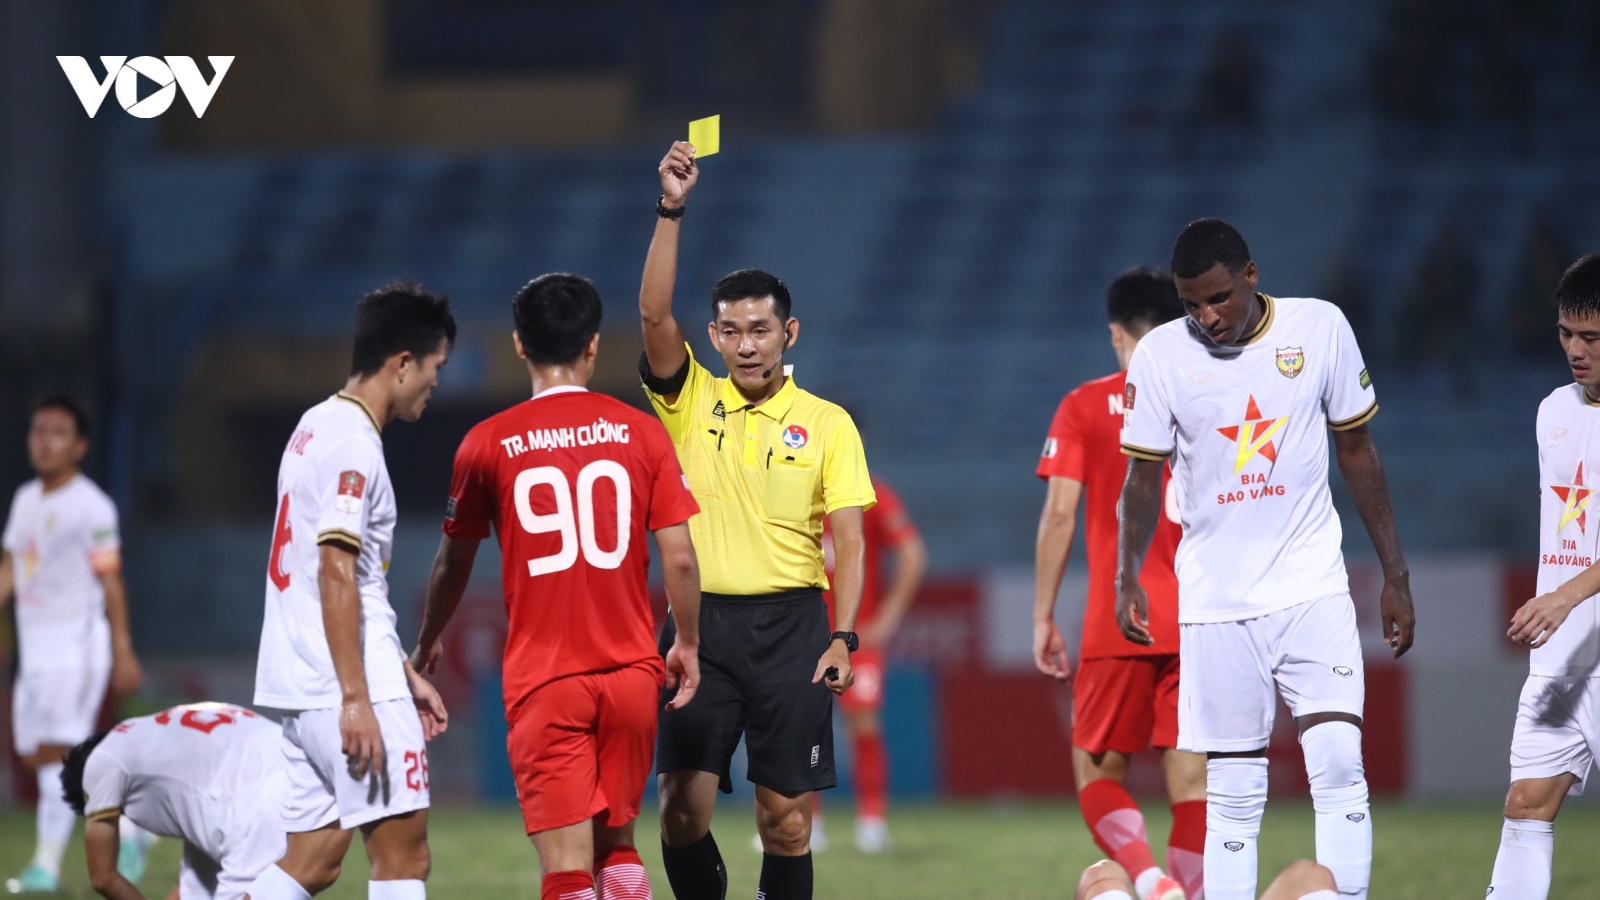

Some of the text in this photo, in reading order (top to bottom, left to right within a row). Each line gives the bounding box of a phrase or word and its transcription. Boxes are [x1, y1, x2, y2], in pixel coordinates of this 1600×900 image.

[501, 416, 629, 458] TR. MẠNH CƯỜNG
[1241, 473, 1266, 485] BIA
[1217, 485, 1285, 505] SAO VNG
[513, 459, 631, 577] 90
[1562, 539, 1577, 550] BIA
[1542, 554, 1564, 566] SAO
